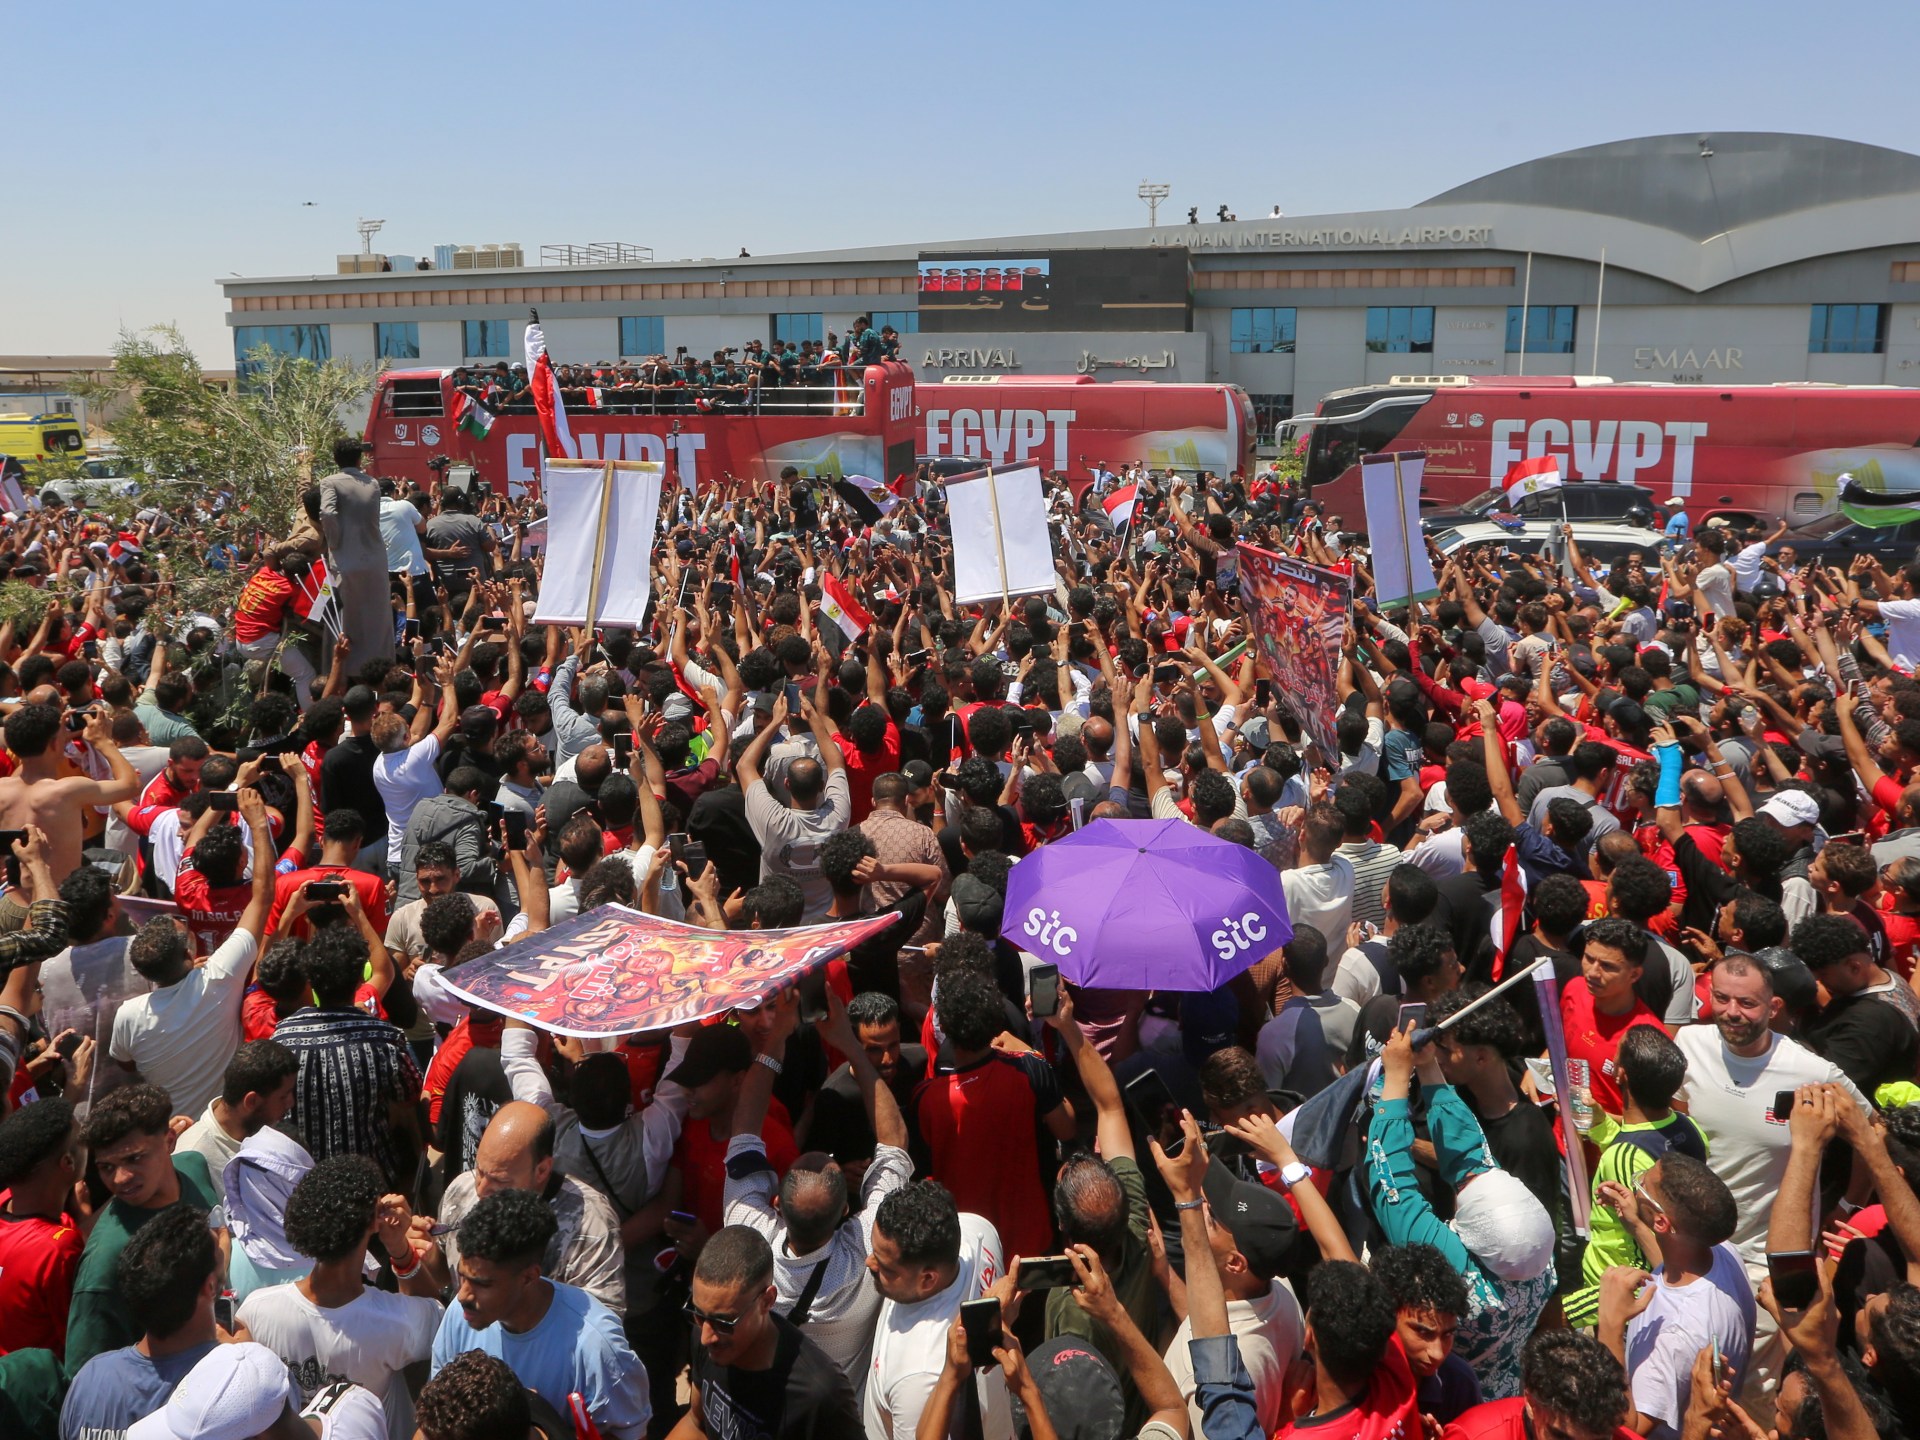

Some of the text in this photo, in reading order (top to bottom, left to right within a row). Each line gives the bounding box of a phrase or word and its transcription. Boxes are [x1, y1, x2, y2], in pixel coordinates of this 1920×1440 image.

[1239, 228, 1395, 246] INTERNATIONAL
[1402, 225, 1492, 244] AIRPORT
[922, 349, 1022, 368] ARRIVAL
[1633, 347, 1743, 370] EMAAR
[890, 386, 912, 421] EGYPT
[926, 408, 1076, 471] EGYPT
[1490, 418, 1708, 497] EGYPT
[192, 909, 245, 922] M.SALA
[1023, 907, 1078, 955] stc
[1211, 912, 1267, 960] stc
